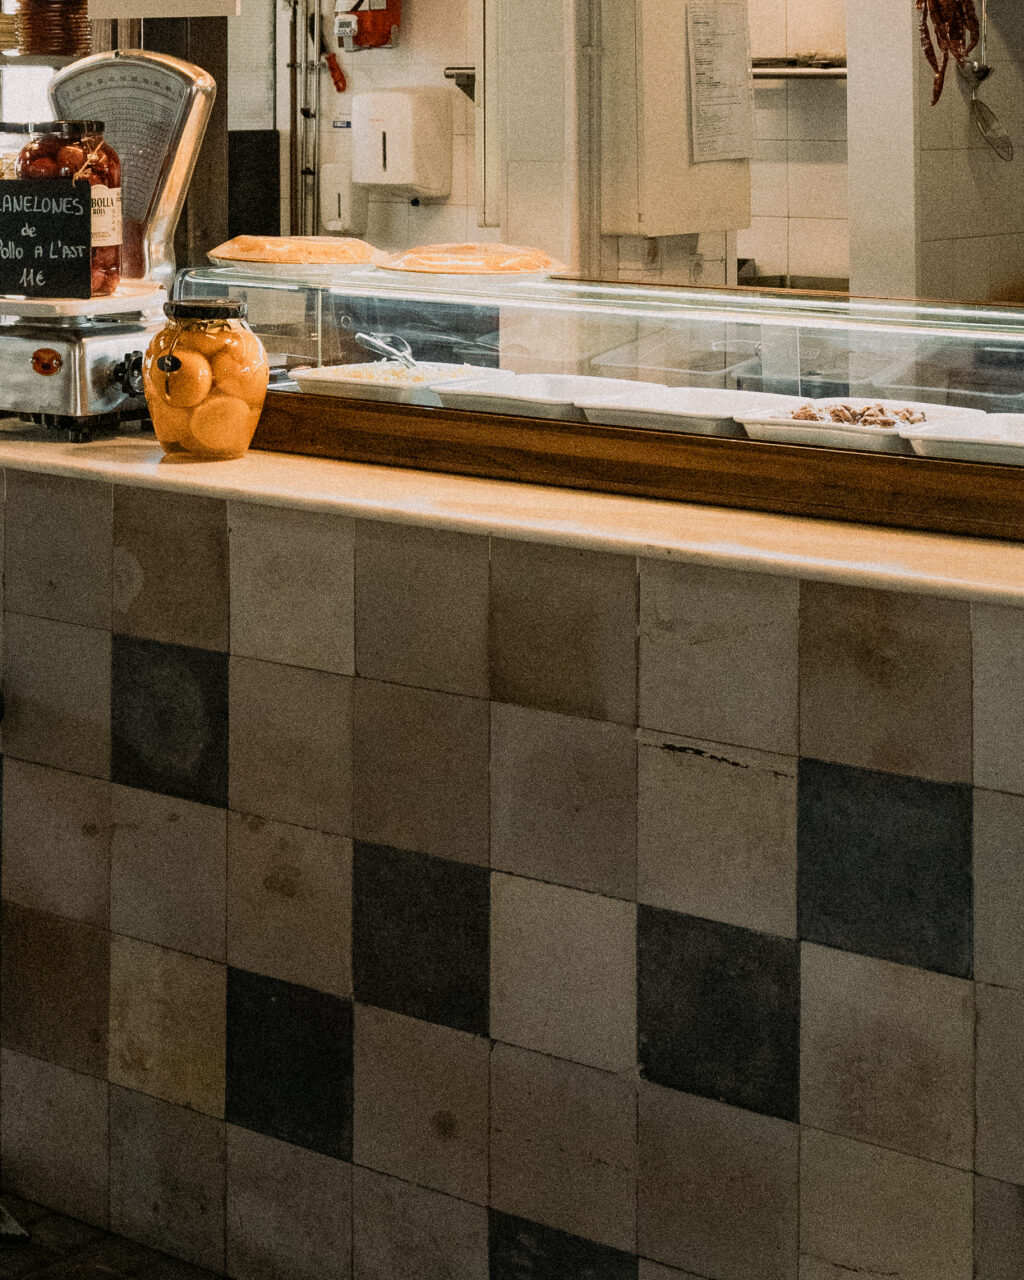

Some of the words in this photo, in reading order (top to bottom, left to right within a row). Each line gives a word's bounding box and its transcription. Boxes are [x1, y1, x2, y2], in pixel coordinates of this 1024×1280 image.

[91, 197, 114, 208] BOLLA
[21, 223, 37, 237] de
[35, 246, 43, 259] A
[19, 269, 46, 287] 11€
